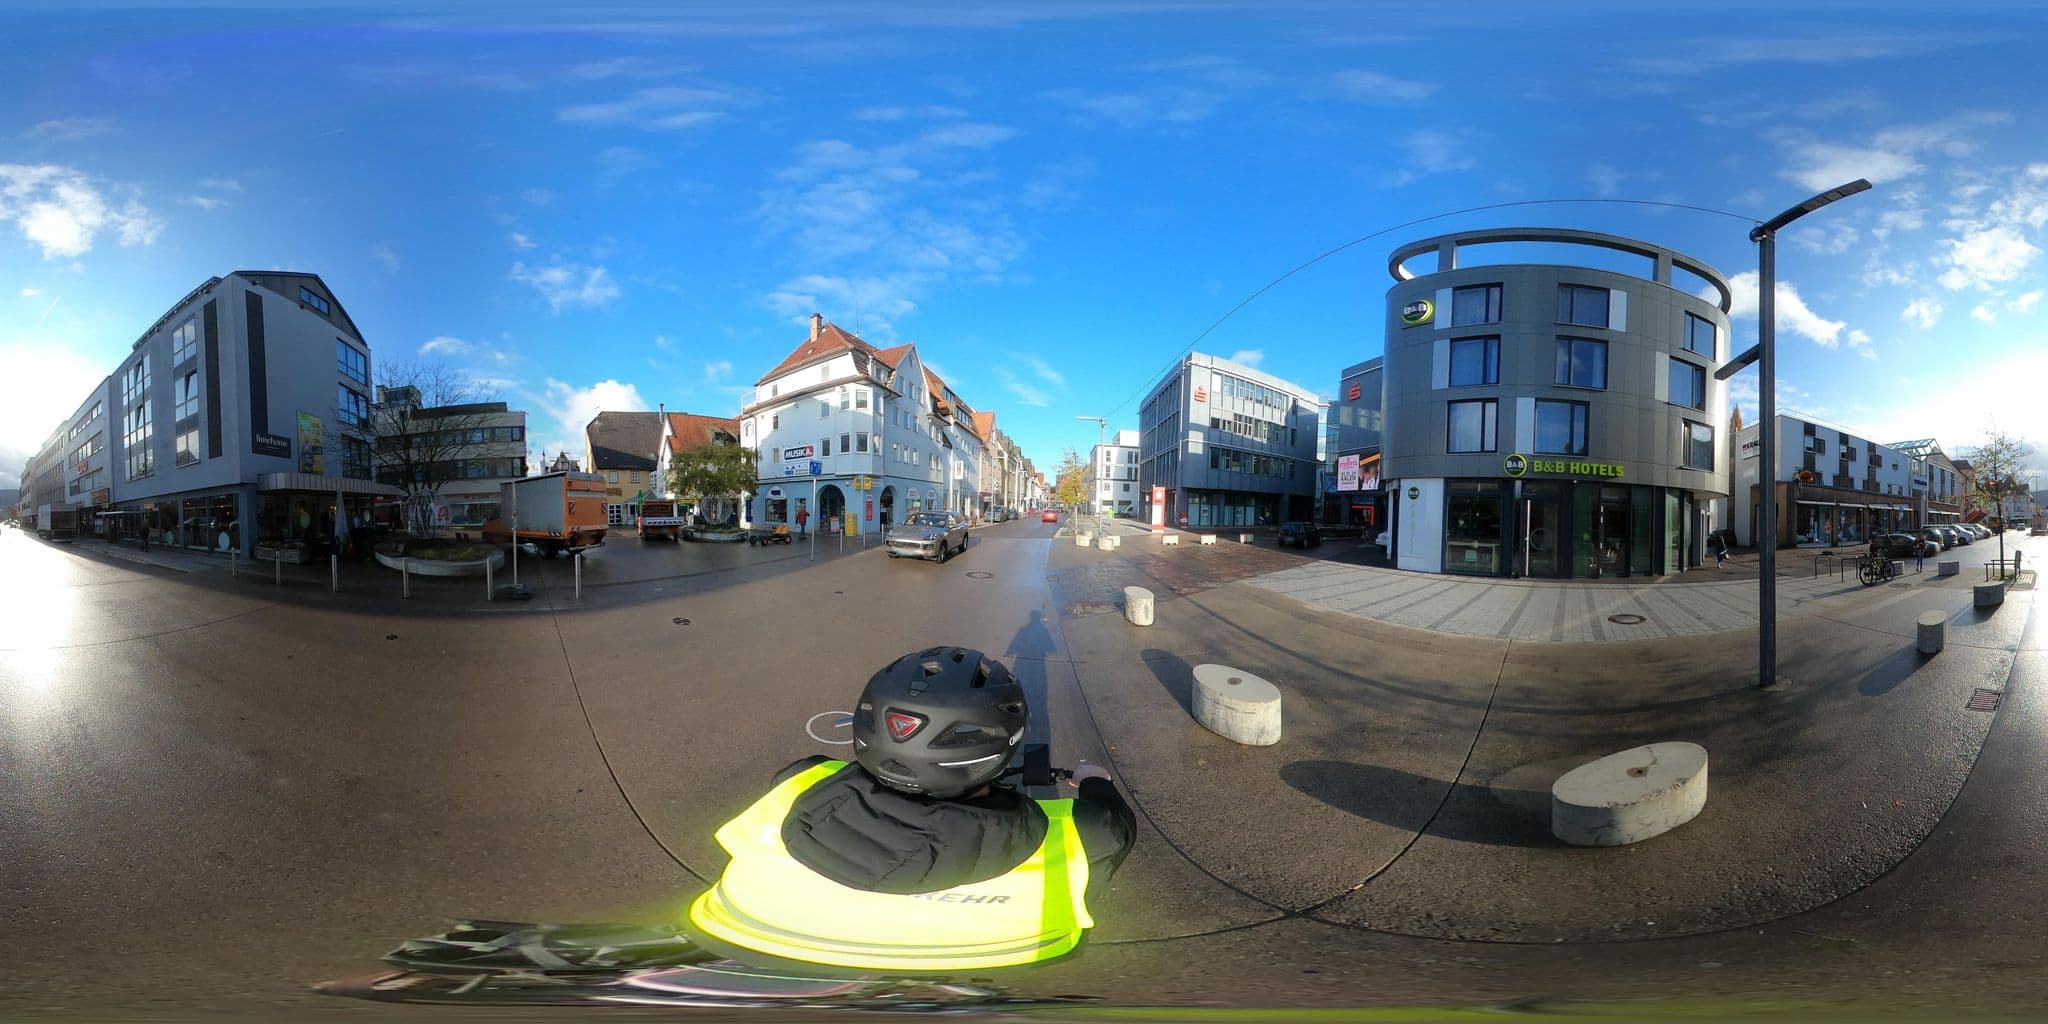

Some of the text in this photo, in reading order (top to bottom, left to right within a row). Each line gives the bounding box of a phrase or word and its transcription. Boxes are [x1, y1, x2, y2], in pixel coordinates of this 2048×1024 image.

[1403, 303, 1427, 315] B&B
[256, 434, 288, 447] limehome
[1506, 460, 1524, 468] B&B
[1534, 460, 1624, 477] B&B HOTELS
